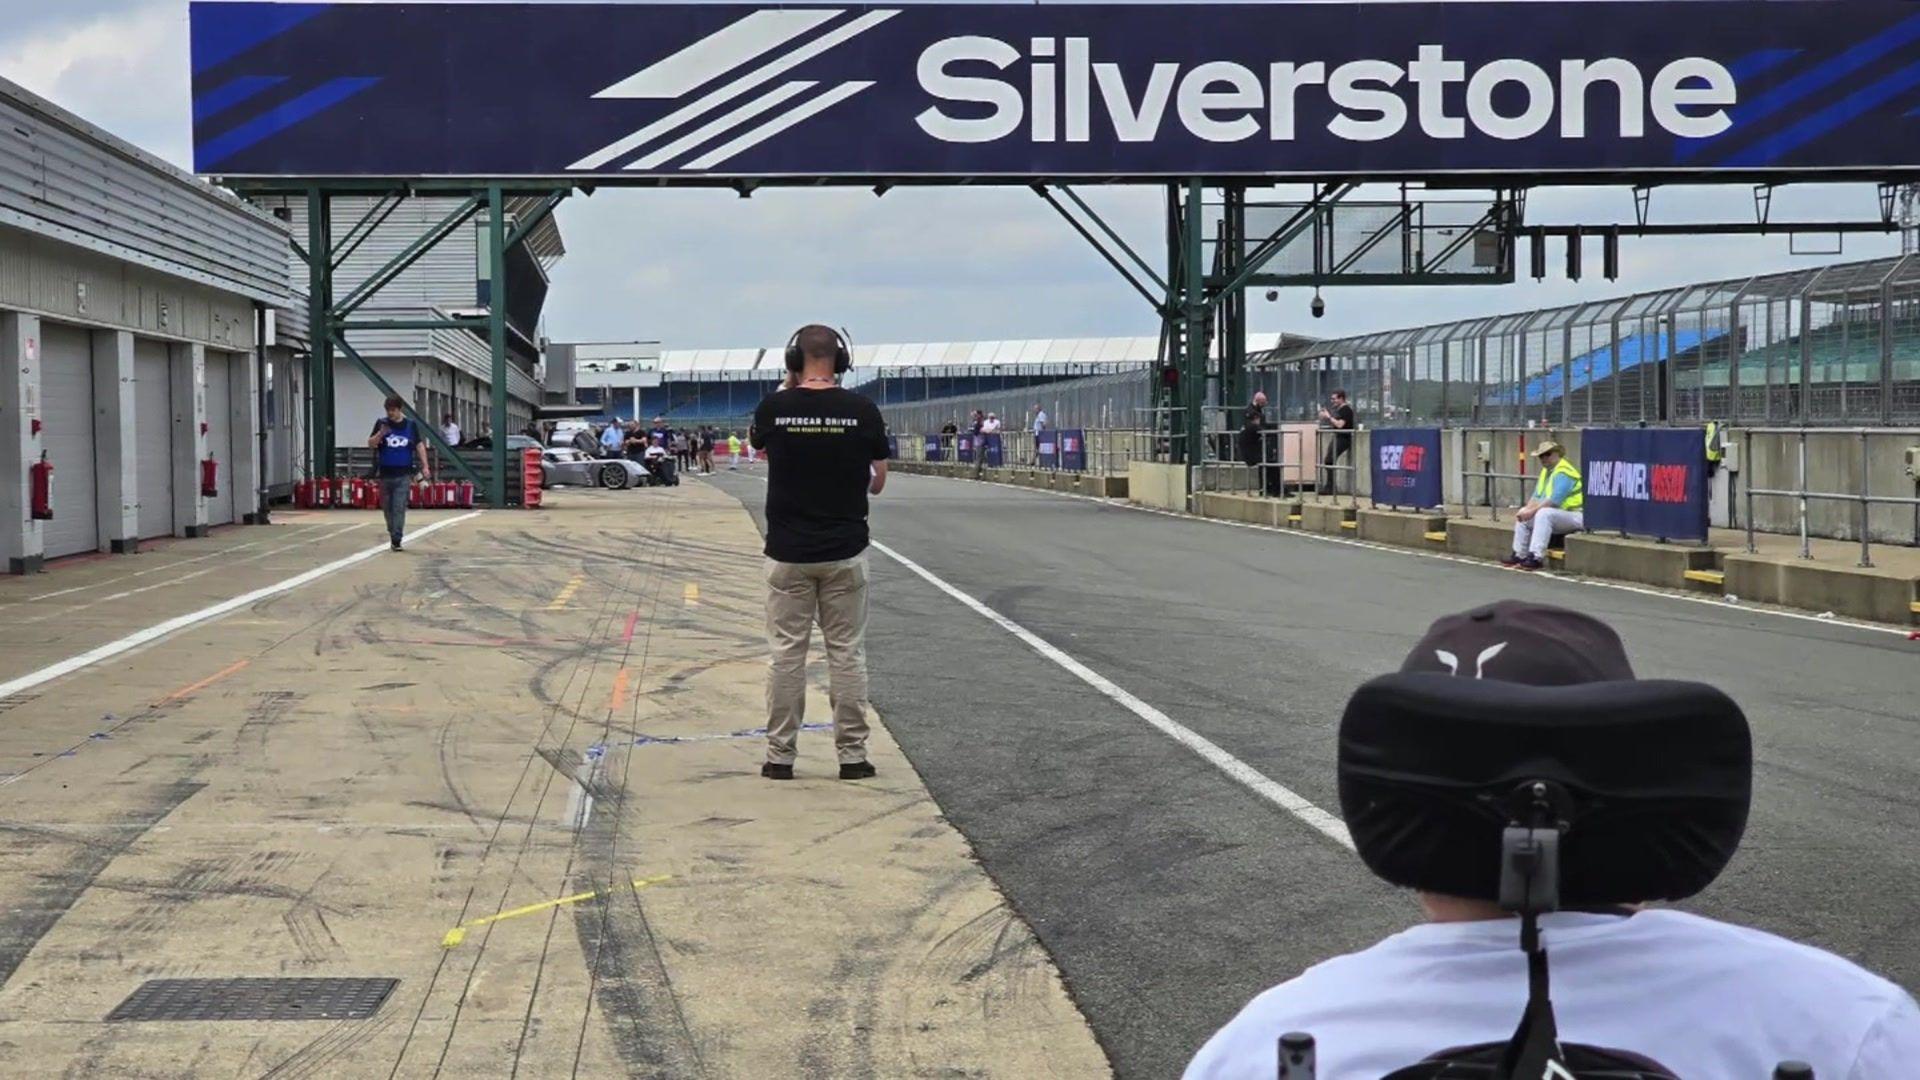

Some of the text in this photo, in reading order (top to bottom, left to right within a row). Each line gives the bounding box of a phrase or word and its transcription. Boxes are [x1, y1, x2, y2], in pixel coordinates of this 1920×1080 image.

[915, 35, 1737, 142] Silverstone
[775, 417, 858, 426] SUPERCAR DRIVER
